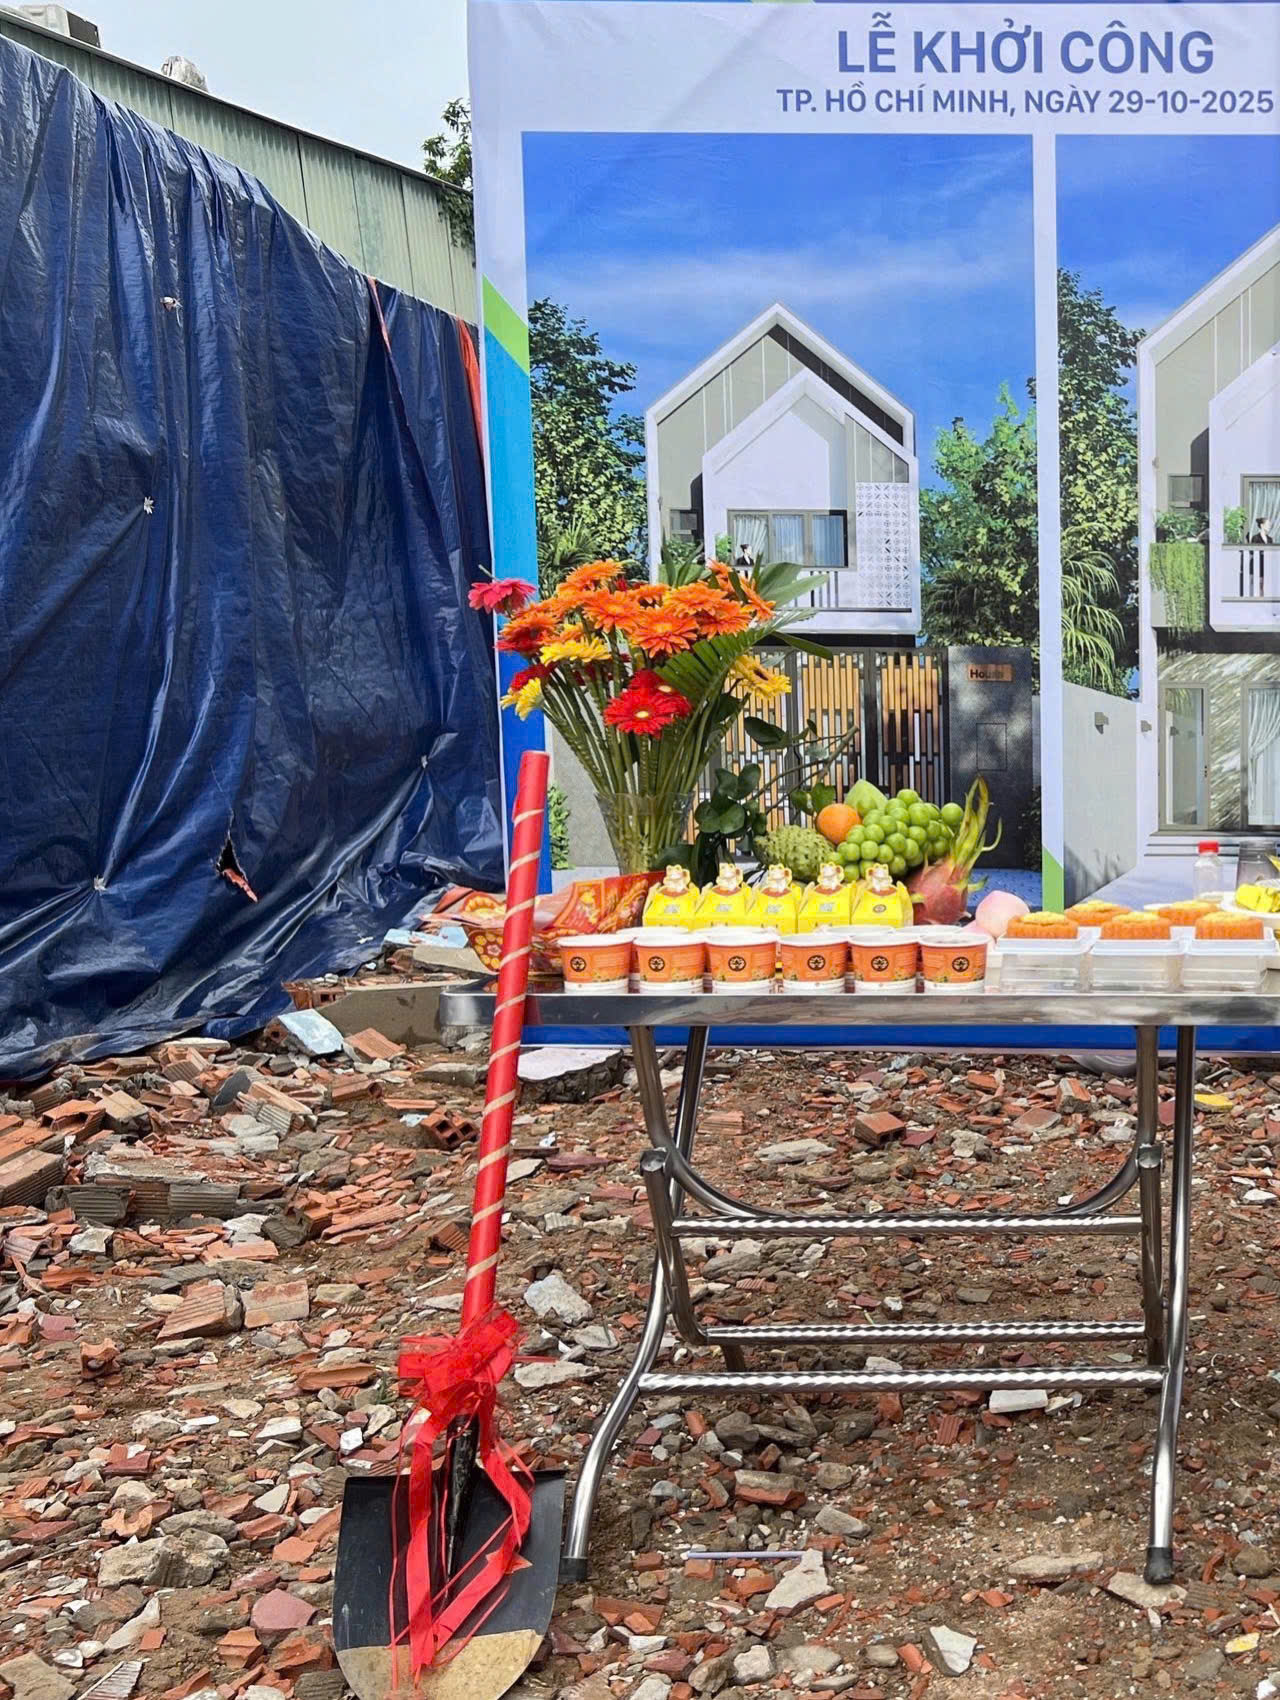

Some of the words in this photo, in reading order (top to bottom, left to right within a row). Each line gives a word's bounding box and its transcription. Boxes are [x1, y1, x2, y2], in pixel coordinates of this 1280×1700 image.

[839, 12, 896, 72] LỄ
[914, 18, 1042, 73] KHỞI
[1061, 21, 1213, 74] CÔNG
[776, 90, 816, 112] TP.
[826, 81, 866, 112] HỒ
[875, 84, 925, 112] CHÍ
[933, 90, 1015, 117] MINH,
[1025, 85, 1101, 113] NGÀY
[1109, 90, 1273, 113] 29-10-2025
